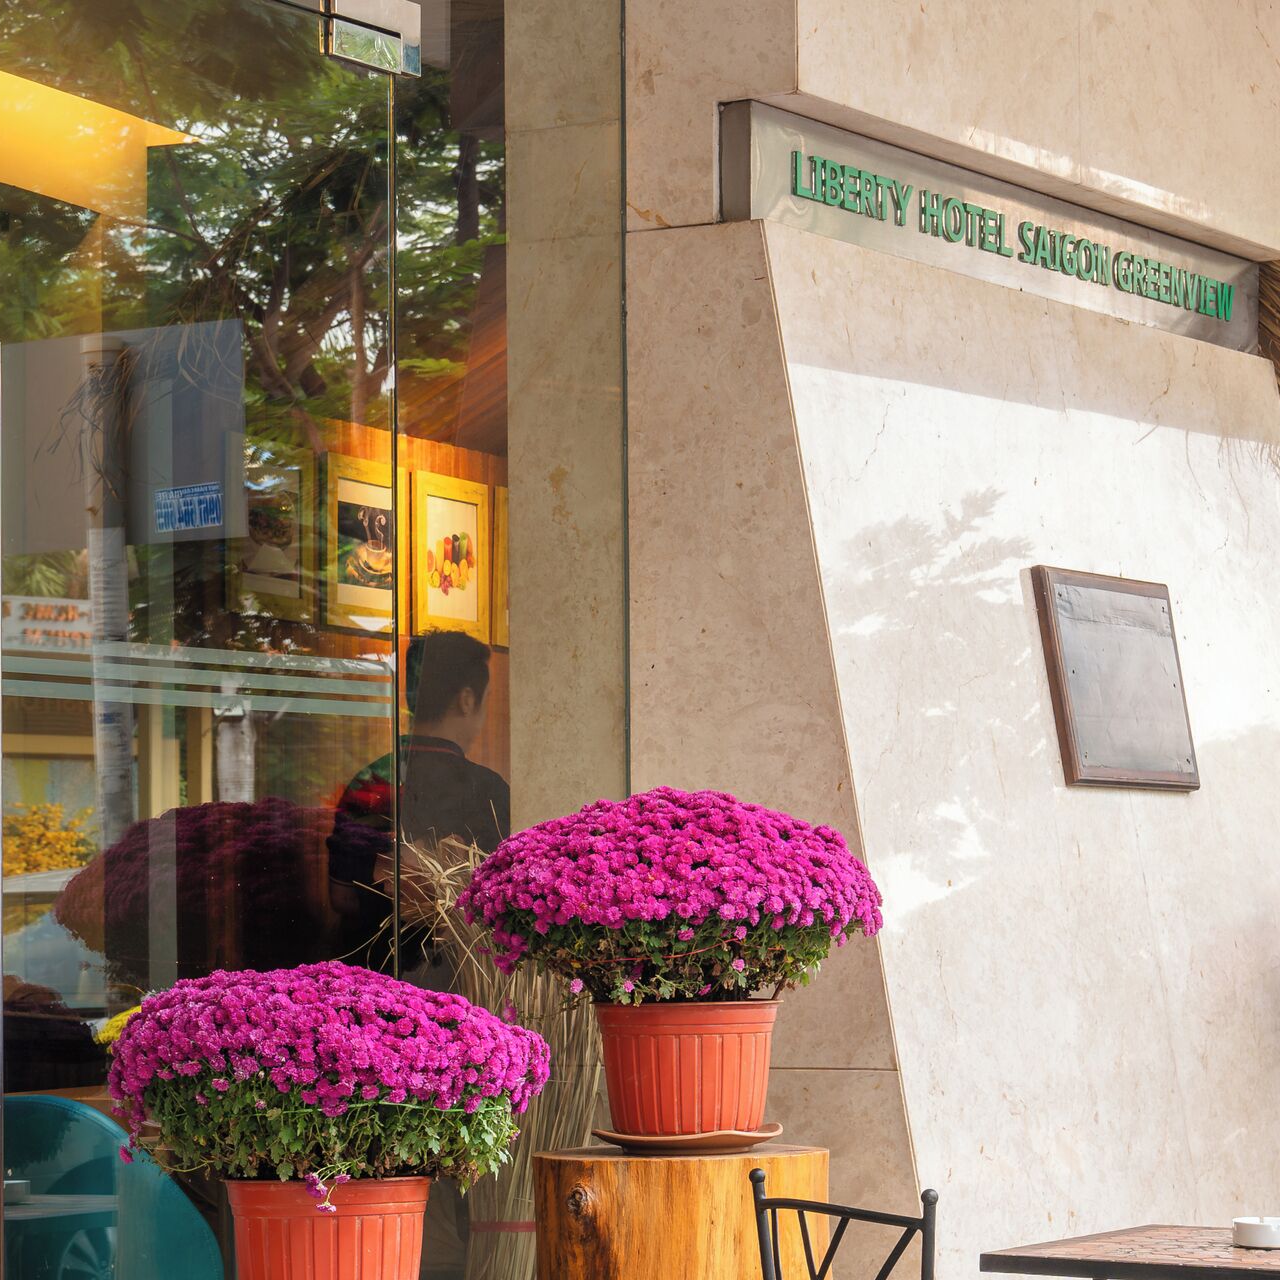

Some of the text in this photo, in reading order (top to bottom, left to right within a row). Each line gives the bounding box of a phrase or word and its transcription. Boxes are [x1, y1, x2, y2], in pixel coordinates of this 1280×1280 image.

[791, 150, 1235, 322] LIBERTY HOTEL SAIGON GREENVIEW
